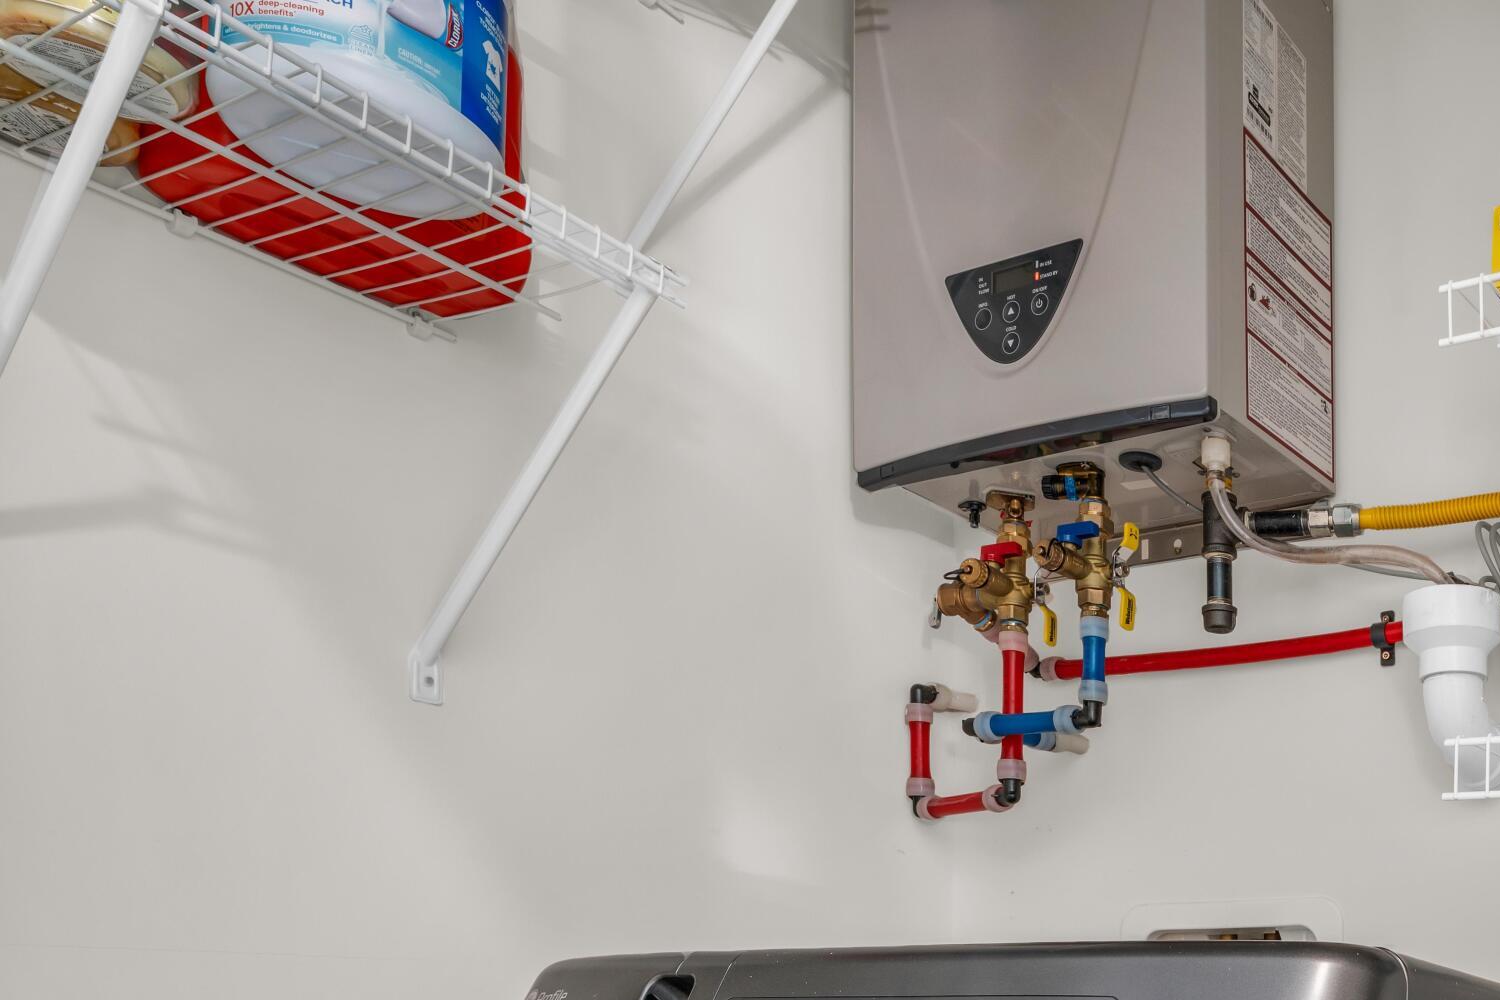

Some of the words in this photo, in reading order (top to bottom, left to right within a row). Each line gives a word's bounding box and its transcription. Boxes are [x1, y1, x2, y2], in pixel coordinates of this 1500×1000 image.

[230, 1, 255, 17] 10X
[258, 0, 325, 16] deep-cleaning
[291, 26, 338, 42] deodorizes
[448, 8, 461, 48] CLOROX
